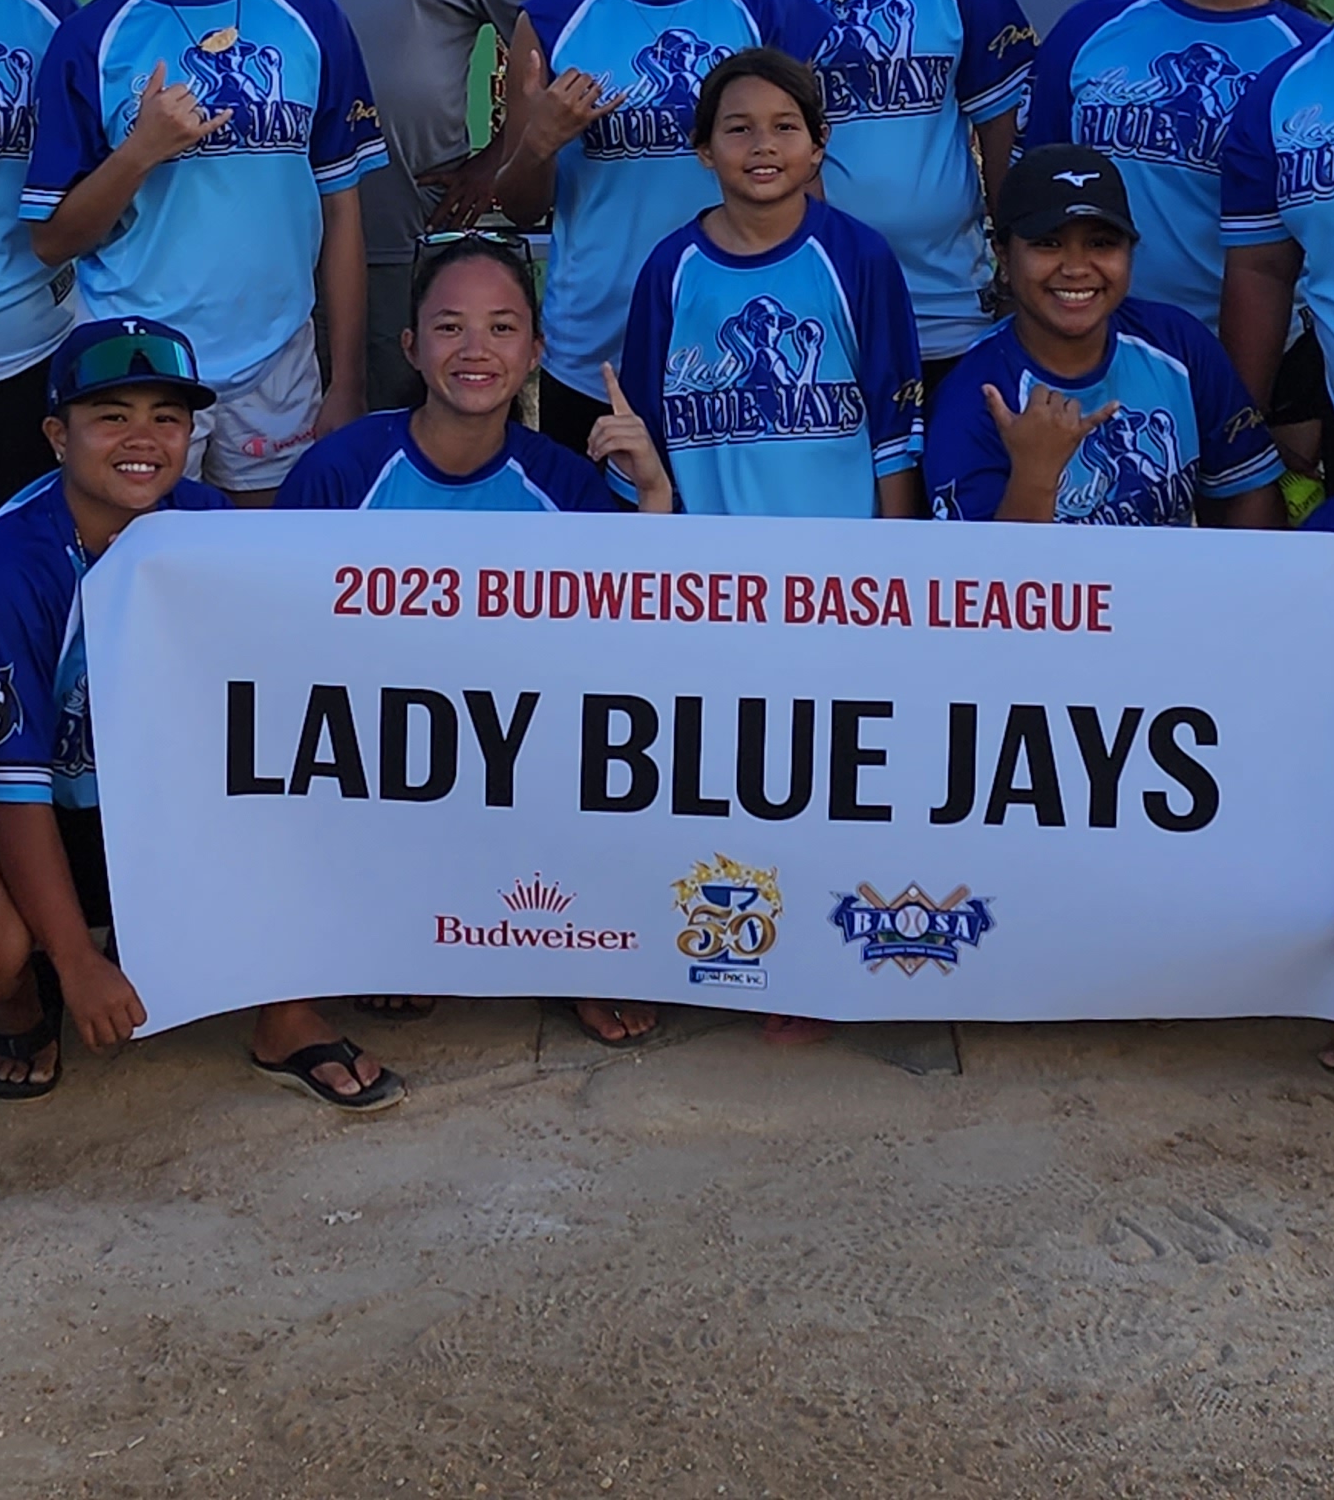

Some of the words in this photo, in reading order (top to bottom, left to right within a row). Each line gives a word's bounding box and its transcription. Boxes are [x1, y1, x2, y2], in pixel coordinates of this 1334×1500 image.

[333, 566, 461, 618] 2023
[477, 568, 768, 623] BUDWEISER
[784, 575, 912, 627] BASA
[928, 580, 1112, 632] LEAGUE
[226, 681, 542, 808] LADY
[579, 693, 894, 822] BLUE
[929, 702, 1221, 833] JAYS
[433, 914, 636, 950] Budweiser
